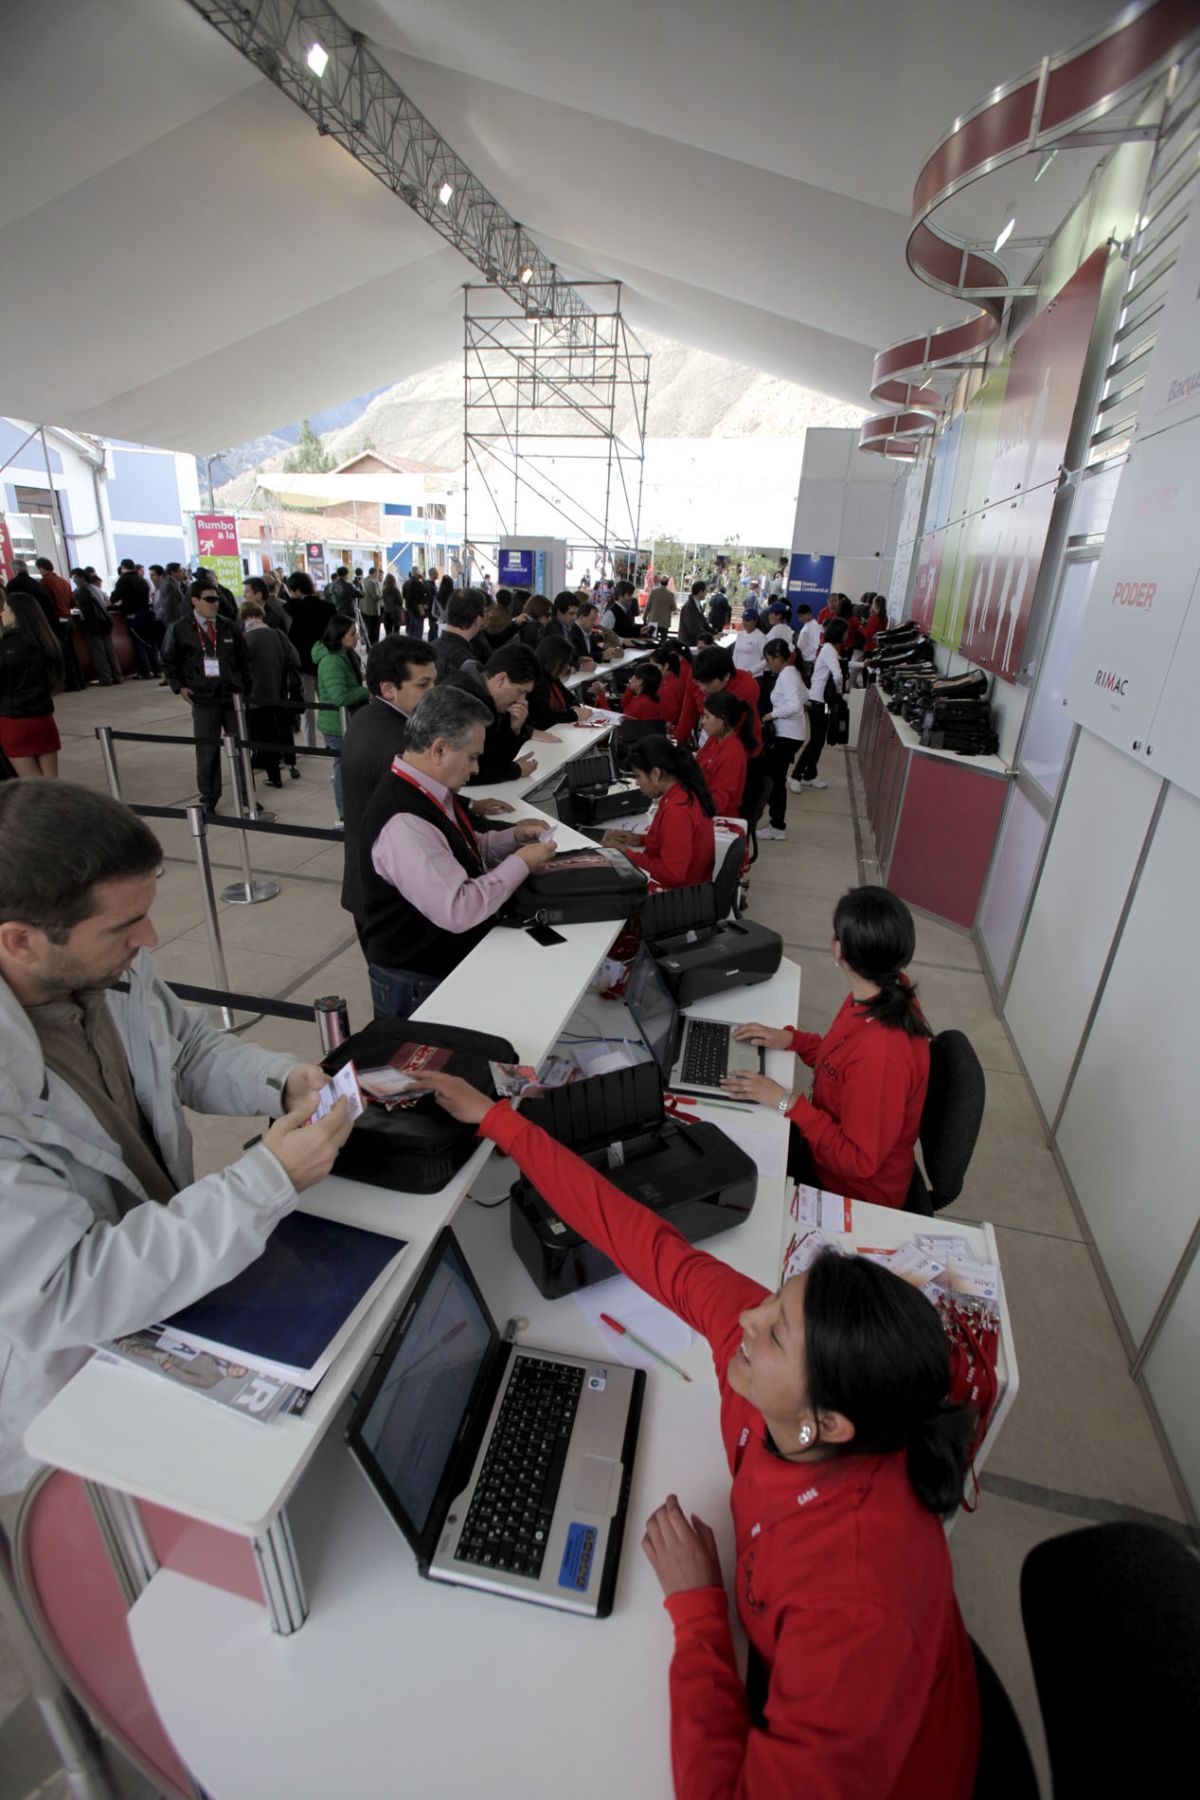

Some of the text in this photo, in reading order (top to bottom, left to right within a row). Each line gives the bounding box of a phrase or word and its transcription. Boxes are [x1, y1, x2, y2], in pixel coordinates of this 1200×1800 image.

[198, 520, 234, 530] Rumbo
[226, 531, 235, 540] la
[1112, 582, 1157, 609] PODER
[1094, 669, 1129, 696] RIMAC
[796, 1487, 819, 1505] CADE
